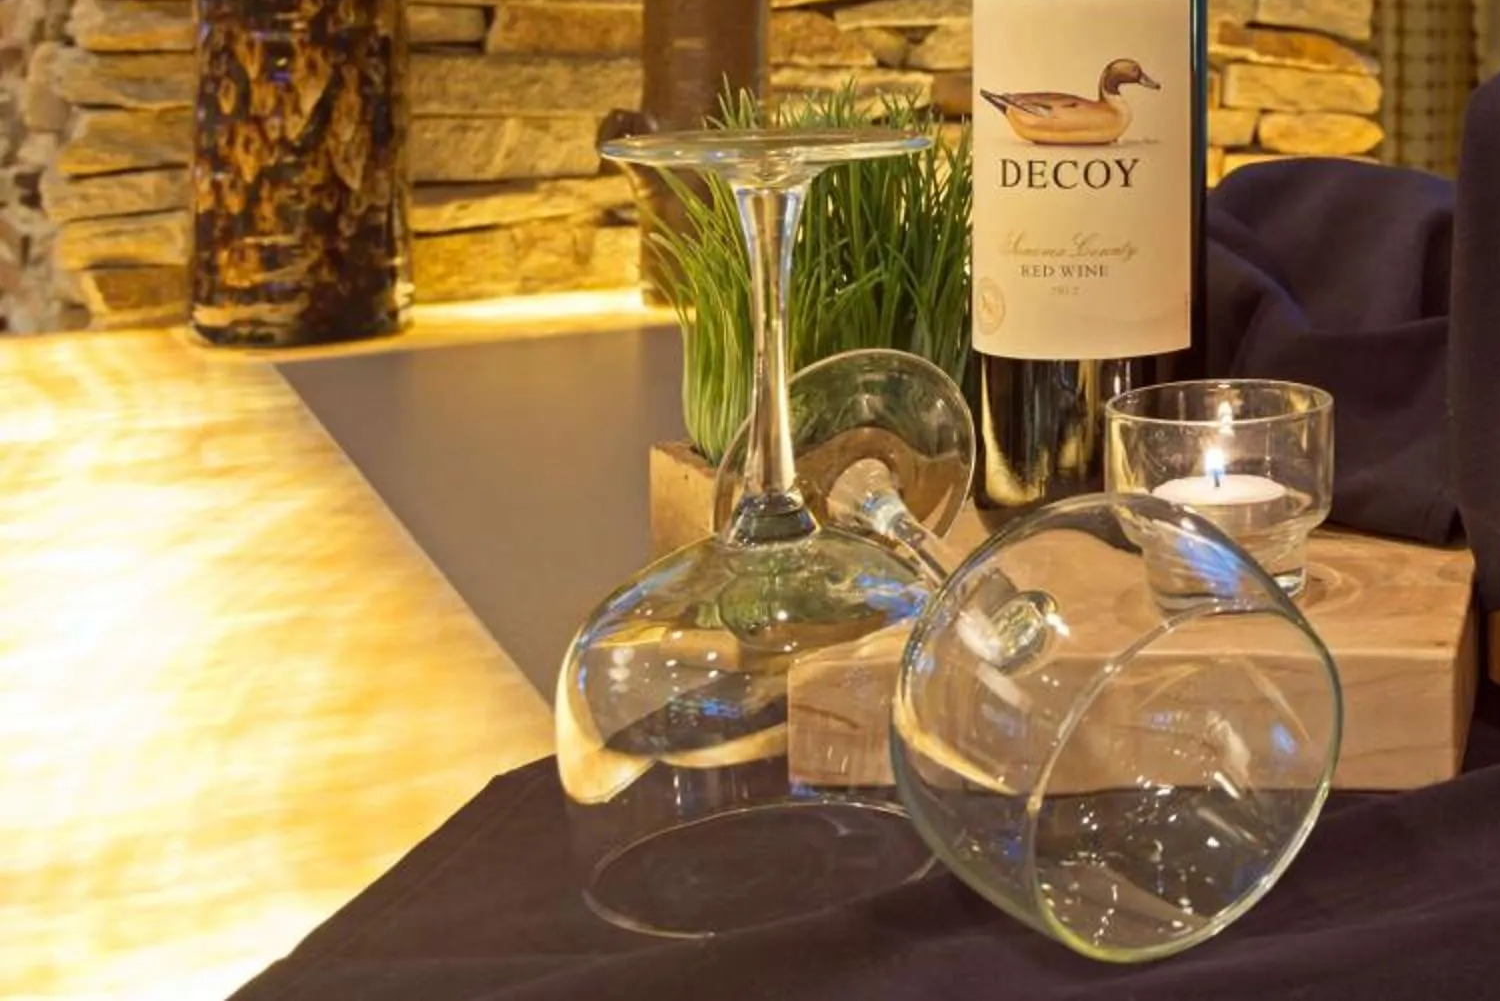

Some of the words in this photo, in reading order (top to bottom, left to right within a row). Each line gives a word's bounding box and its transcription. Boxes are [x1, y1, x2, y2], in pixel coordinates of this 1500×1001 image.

[999, 158, 1141, 190] DECOY
[1069, 231, 1140, 263] County
[1020, 264, 1056, 279] RED
[1061, 264, 1109, 279] WINE
